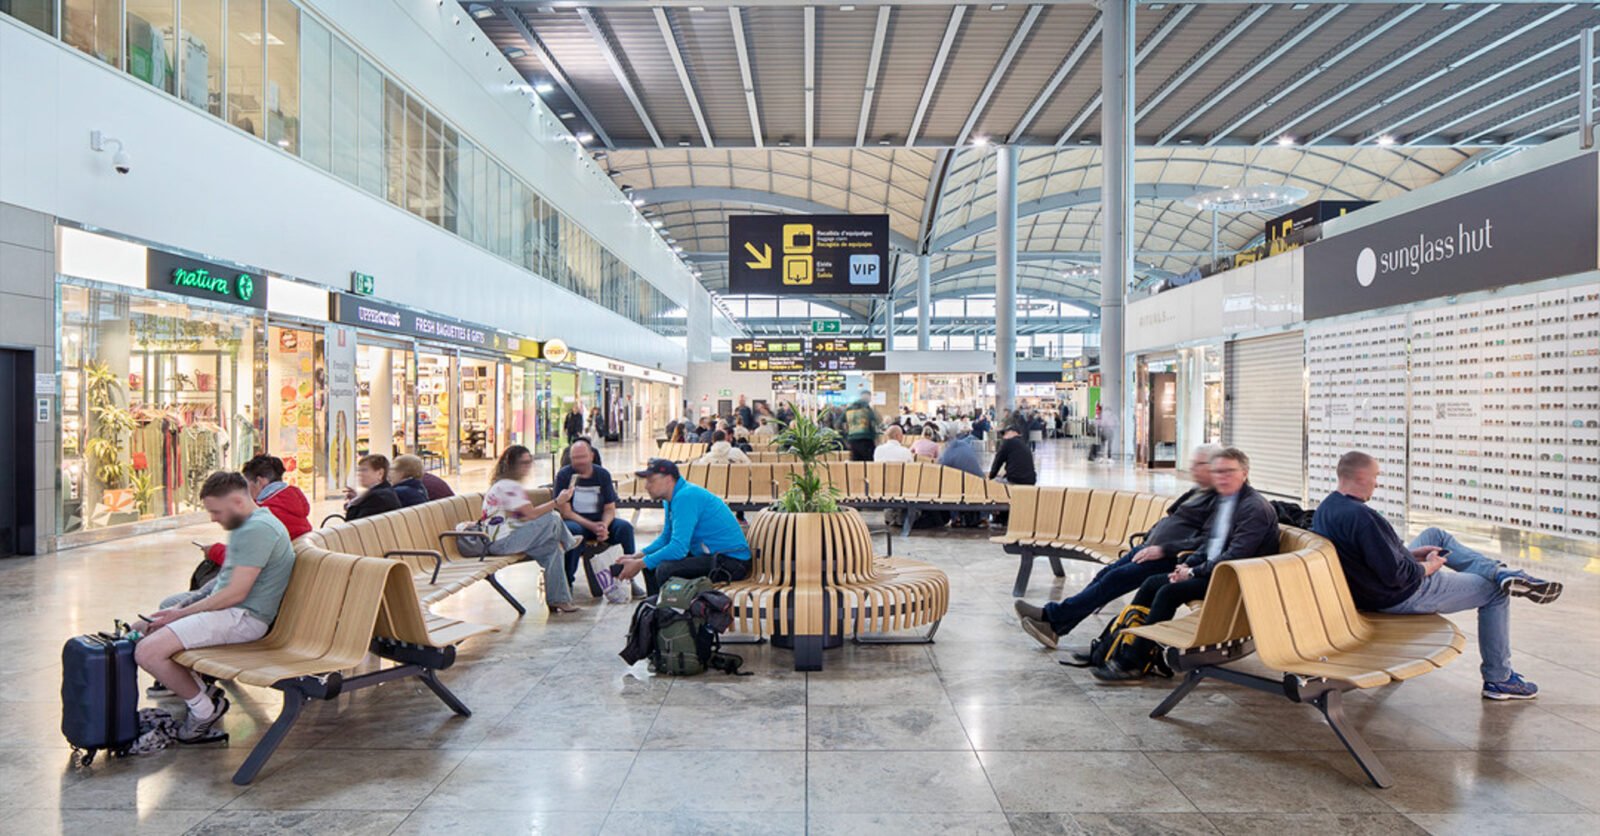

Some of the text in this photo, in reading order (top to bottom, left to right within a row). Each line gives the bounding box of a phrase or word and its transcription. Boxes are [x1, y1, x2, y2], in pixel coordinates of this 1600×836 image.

[1380, 218, 1493, 275] sunglass hut
[175, 268, 230, 295] natura
[853, 263, 877, 275] VIP
[415, 317, 435, 334] FRESH
[436, 321, 466, 340] BAGUETTES
[471, 329, 485, 344] GIFTS
